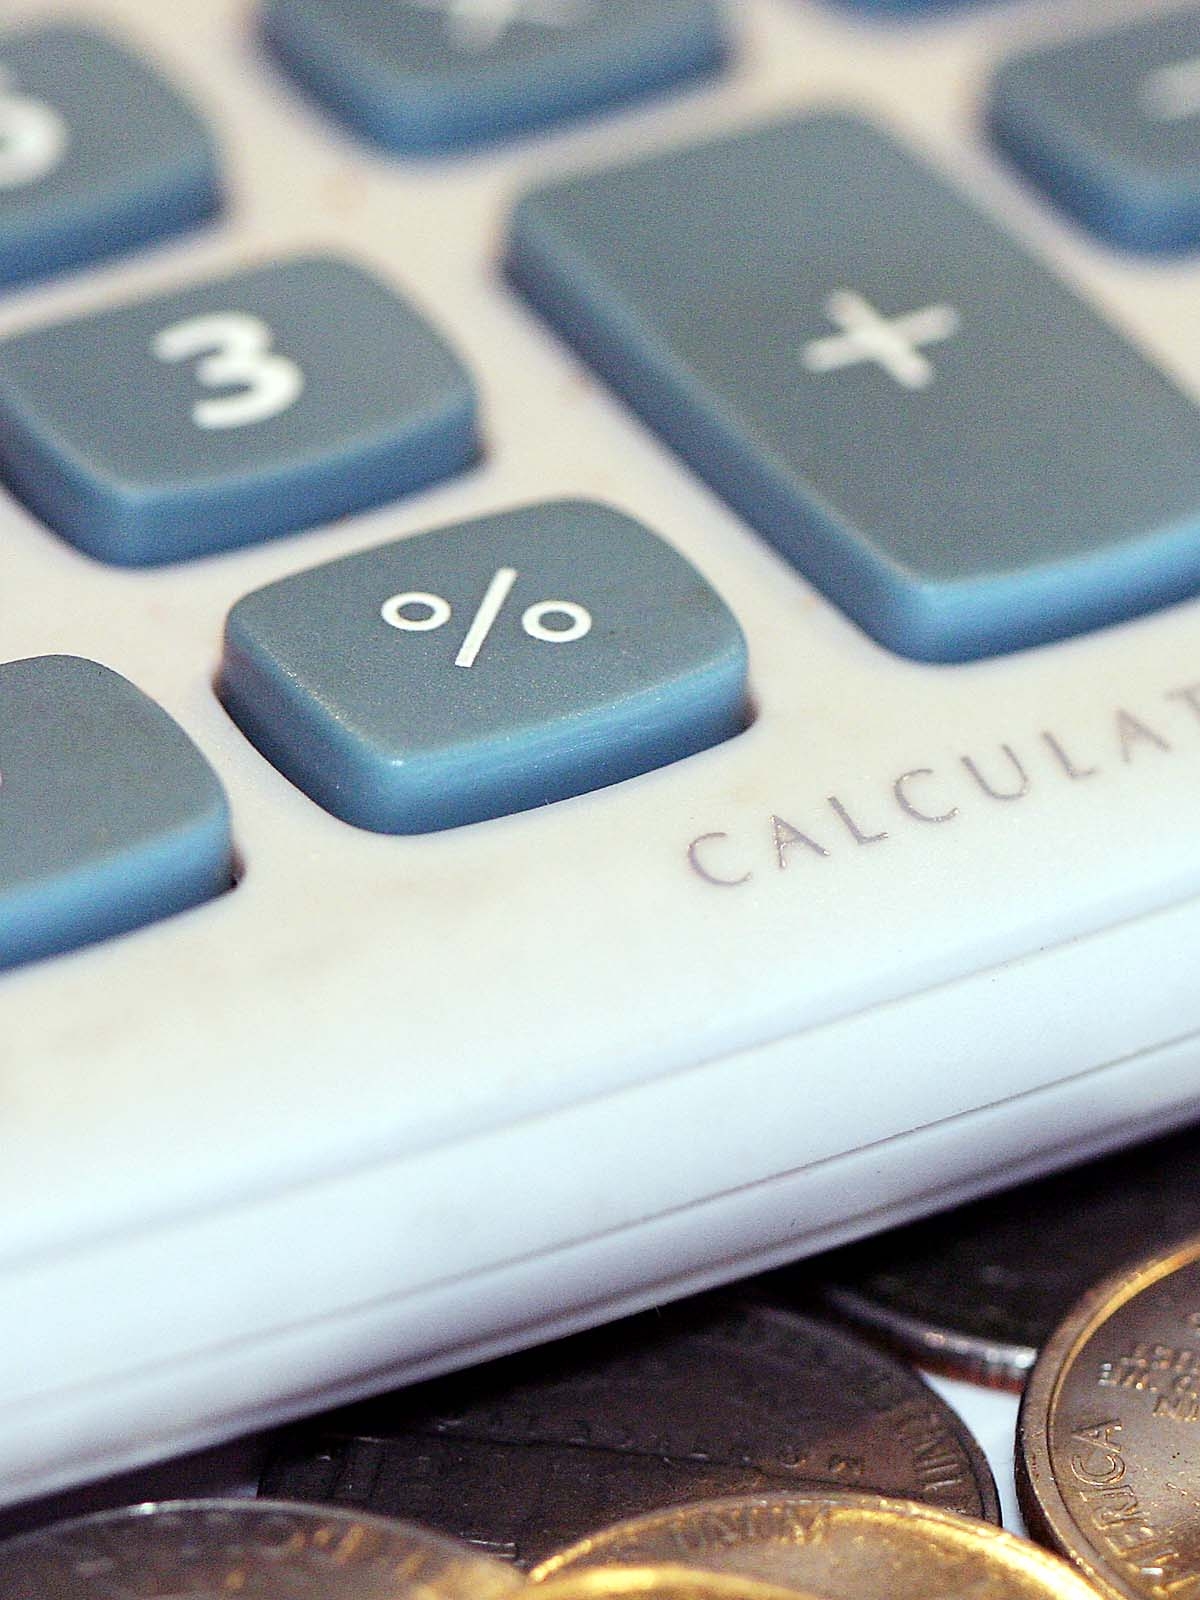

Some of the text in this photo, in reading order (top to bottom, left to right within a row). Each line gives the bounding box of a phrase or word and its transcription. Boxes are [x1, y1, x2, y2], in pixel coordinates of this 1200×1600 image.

[153, 311, 304, 429] 3
[803, 290, 958, 388] +
[380, 567, 592, 667] %
